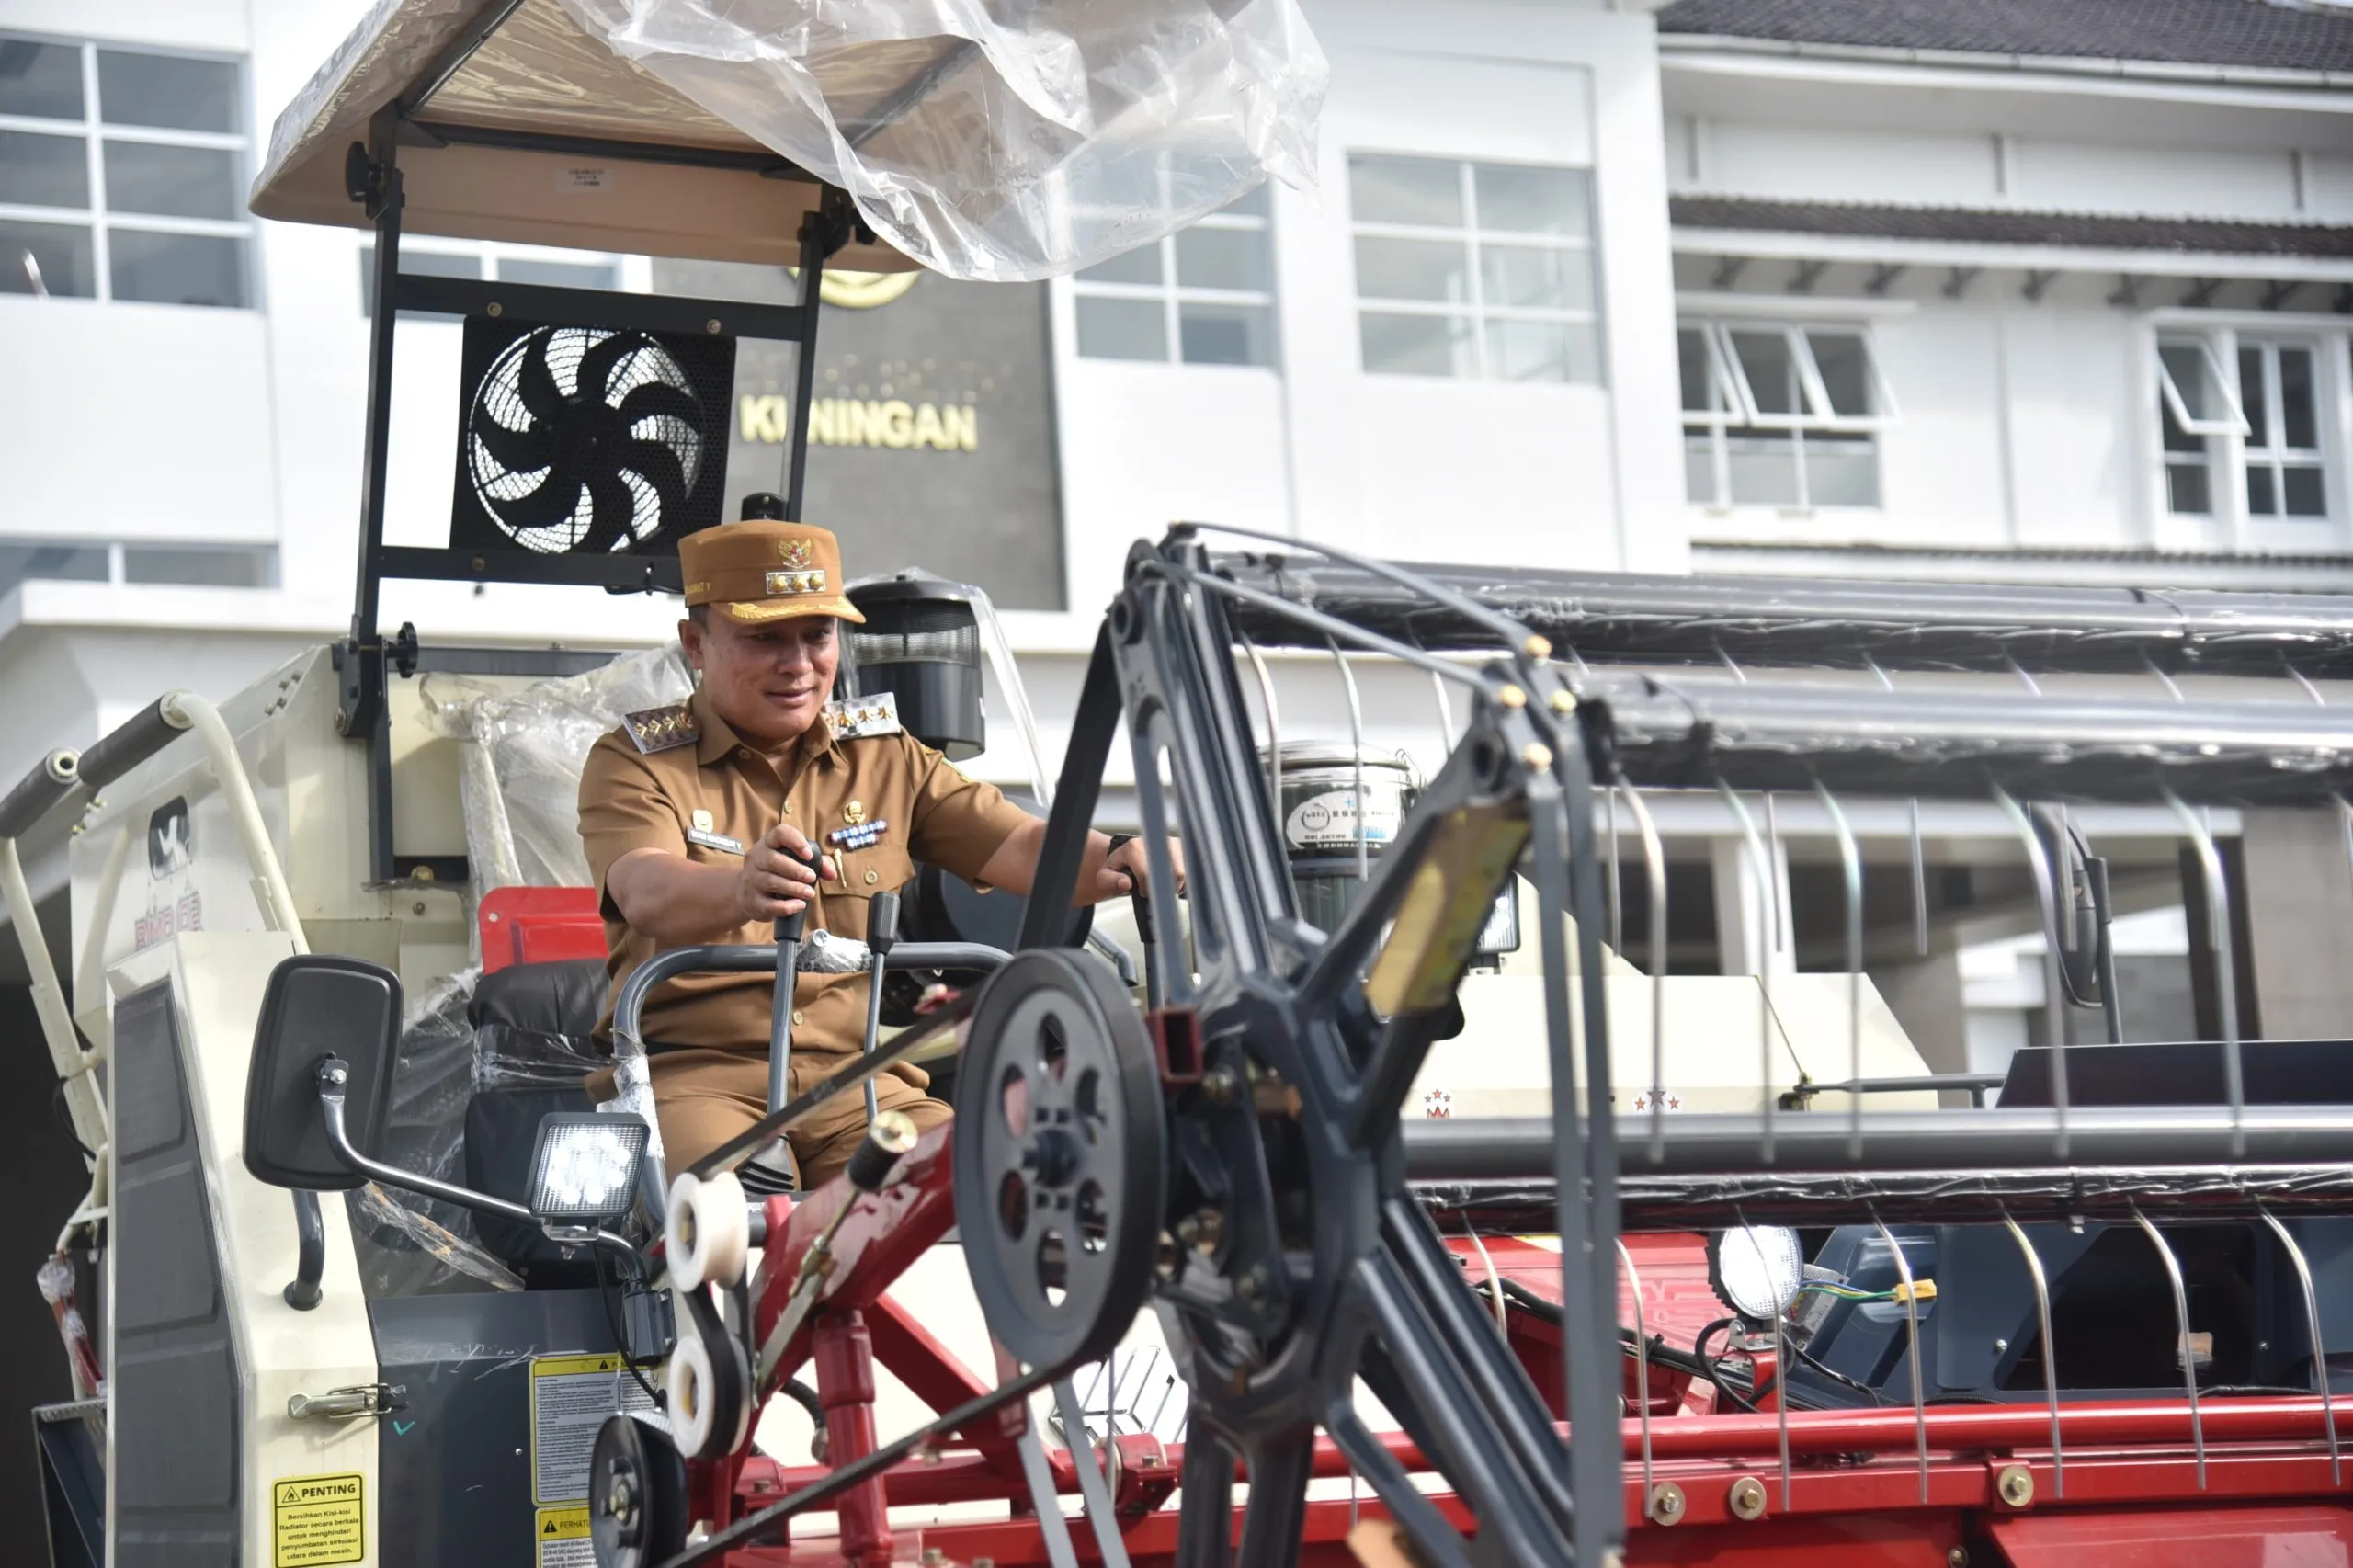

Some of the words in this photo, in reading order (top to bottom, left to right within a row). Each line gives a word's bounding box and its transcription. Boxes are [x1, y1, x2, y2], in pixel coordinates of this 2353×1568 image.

[302, 1484, 355, 1497] PENTING
[288, 1511, 322, 1519] Bersihkan
[324, 1508, 350, 1517] Kisi-kisi
[559, 1519, 589, 1529] PERHATI
[309, 1528, 351, 1538] menghindari
[281, 1540, 328, 1551] penyumbatan
[287, 1551, 306, 1560] udara
[308, 1550, 329, 1558] dalam
